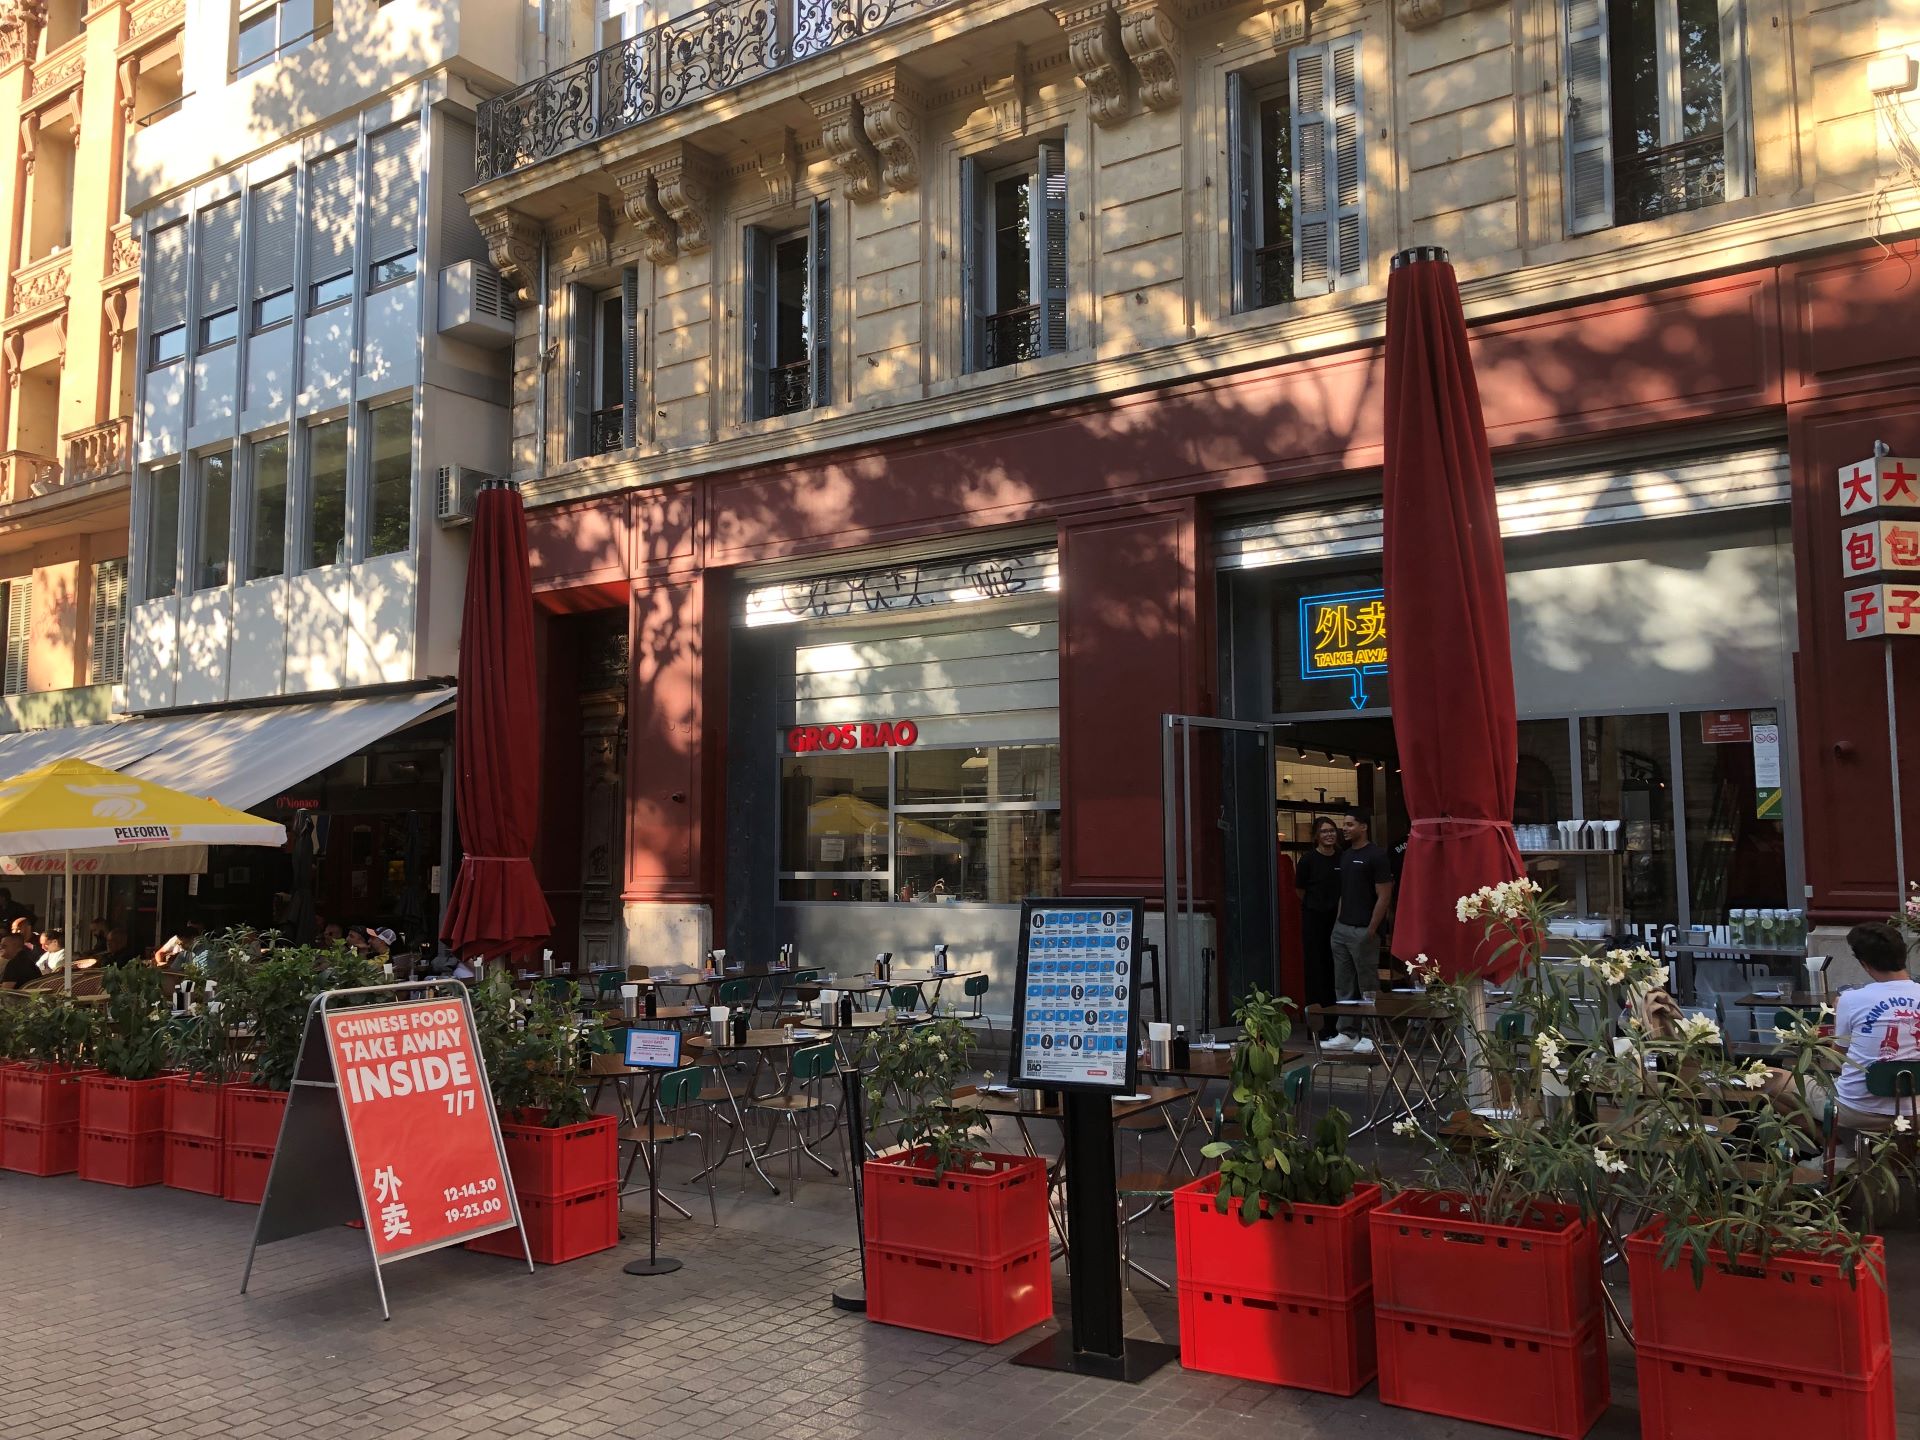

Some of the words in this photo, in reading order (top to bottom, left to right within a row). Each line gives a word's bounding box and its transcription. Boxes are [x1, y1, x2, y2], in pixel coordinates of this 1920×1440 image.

[1843, 467, 1879, 633] 大包子
[1883, 462, 1920, 629] 大包子
[1314, 651, 1354, 667] TAKE
[1355, 647, 1387, 664] AWA
[788, 723, 858, 752] GROS
[860, 720, 918, 748] BAO
[114, 826, 169, 839] PELFORTH
[1888, 996, 1915, 1008] HOT
[336, 1014, 410, 1038] CHINESE
[411, 1008, 459, 1029] FOOD
[340, 1036, 398, 1063] TAKE
[402, 1027, 461, 1055] AWAY
[346, 1052, 471, 1104] INSIDE
[442, 1089, 475, 1116] 7/7
[373, 1165, 412, 1241] 外卖
[443, 1177, 497, 1202] 12-14.30
[445, 1197, 502, 1223] 19-23.00
